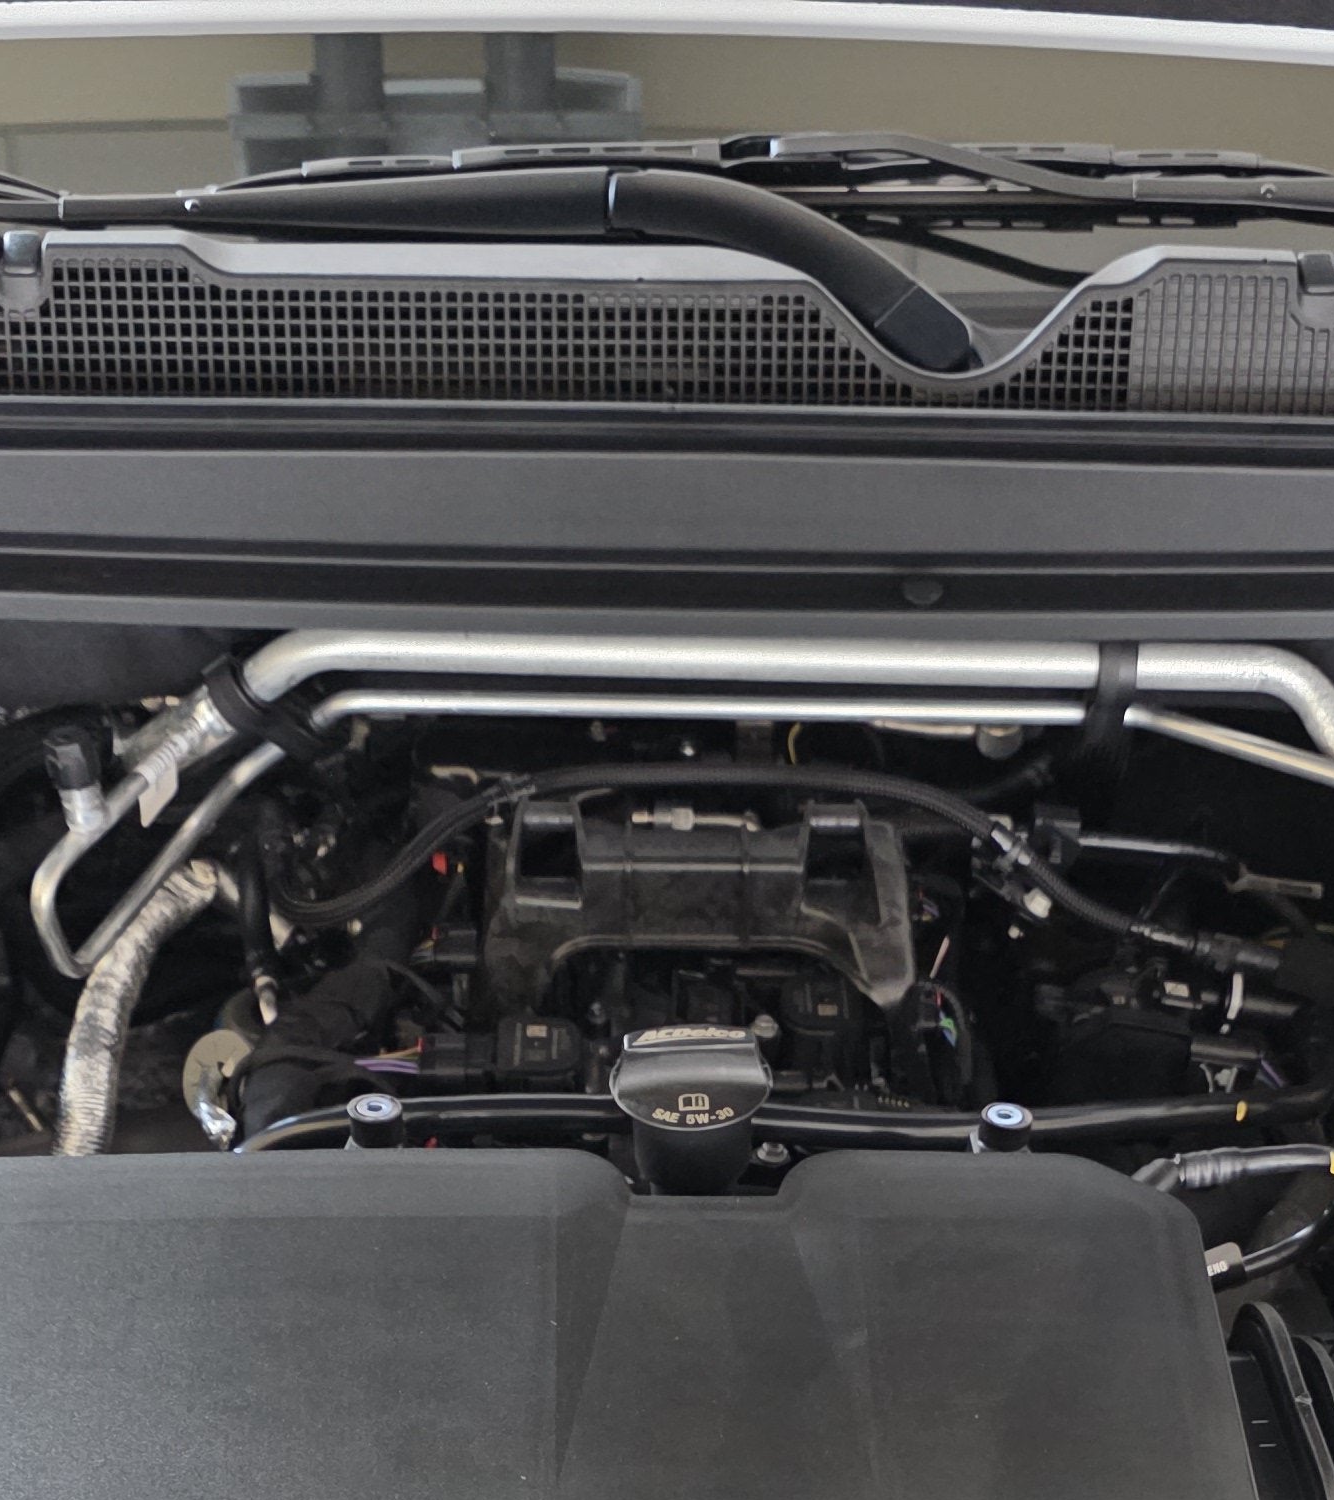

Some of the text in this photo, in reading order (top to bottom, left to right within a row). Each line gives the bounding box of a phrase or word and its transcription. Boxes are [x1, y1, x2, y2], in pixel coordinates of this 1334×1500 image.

[635, 1027, 747, 1043] ACDelco
[652, 1106, 735, 1126] SAE 5W-30
